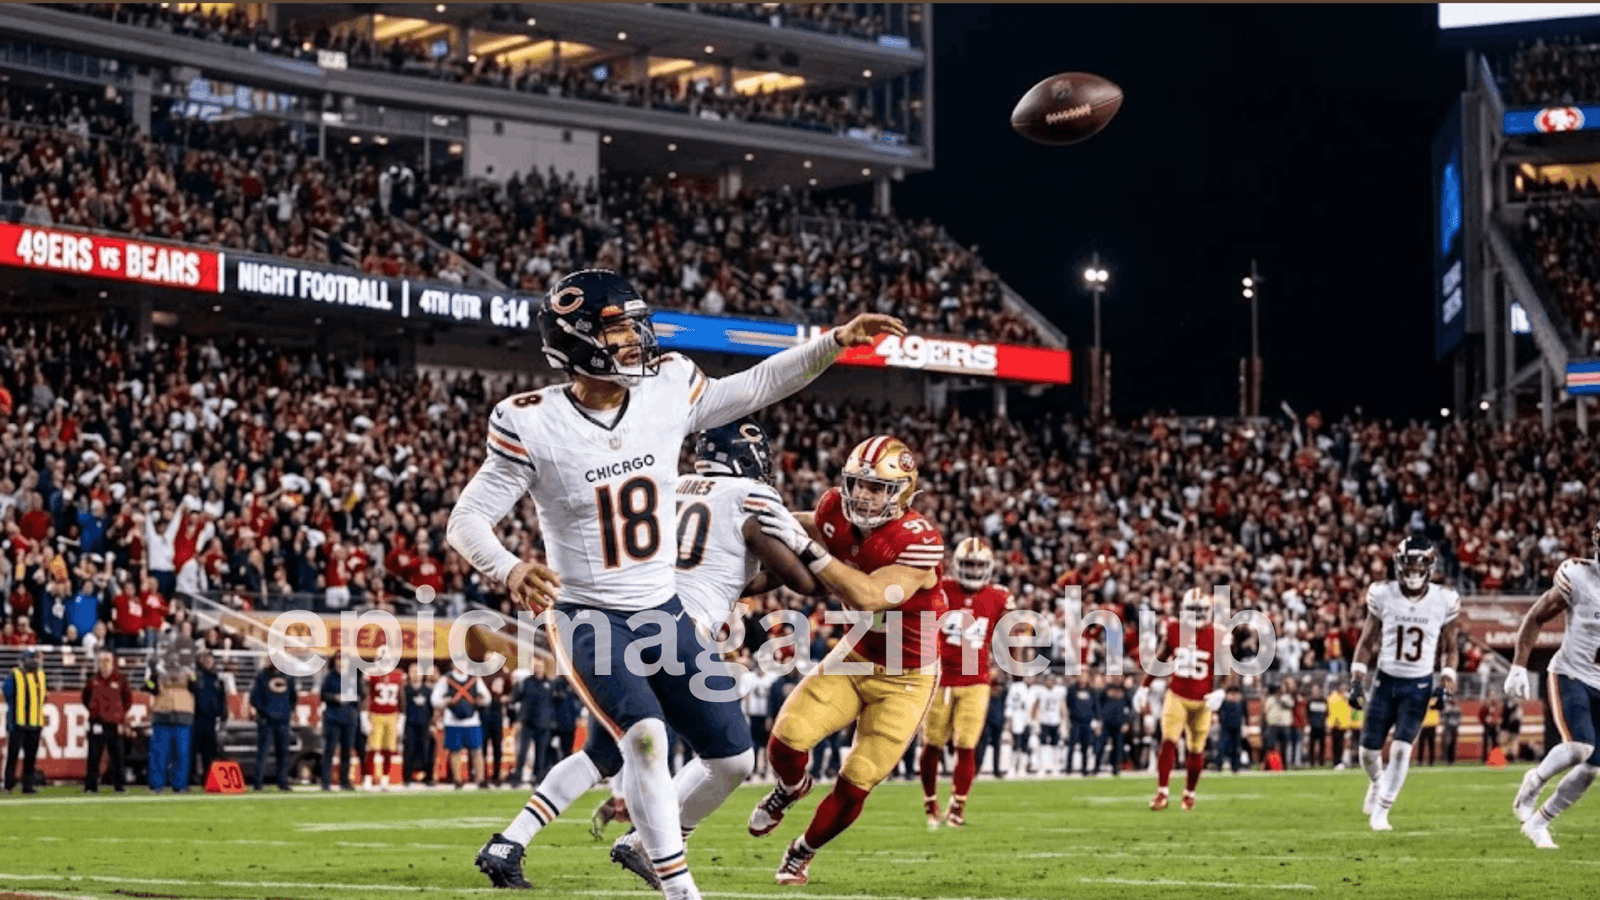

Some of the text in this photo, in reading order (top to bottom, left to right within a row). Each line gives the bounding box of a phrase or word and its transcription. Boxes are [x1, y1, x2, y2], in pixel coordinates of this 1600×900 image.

[17, 229, 93, 271] 49ERS
[126, 243, 200, 286] BEARS
[238, 261, 393, 310] NIGHT FOOTBALL
[490, 295, 529, 328] 6:14
[875, 334, 997, 373] 49ERS
[595, 475, 661, 569] 18
[330, 627, 437, 649] BEARS
[940, 611, 989, 650] 44
[1395, 625, 1424, 662] 13
[219, 765, 243, 789] 30
